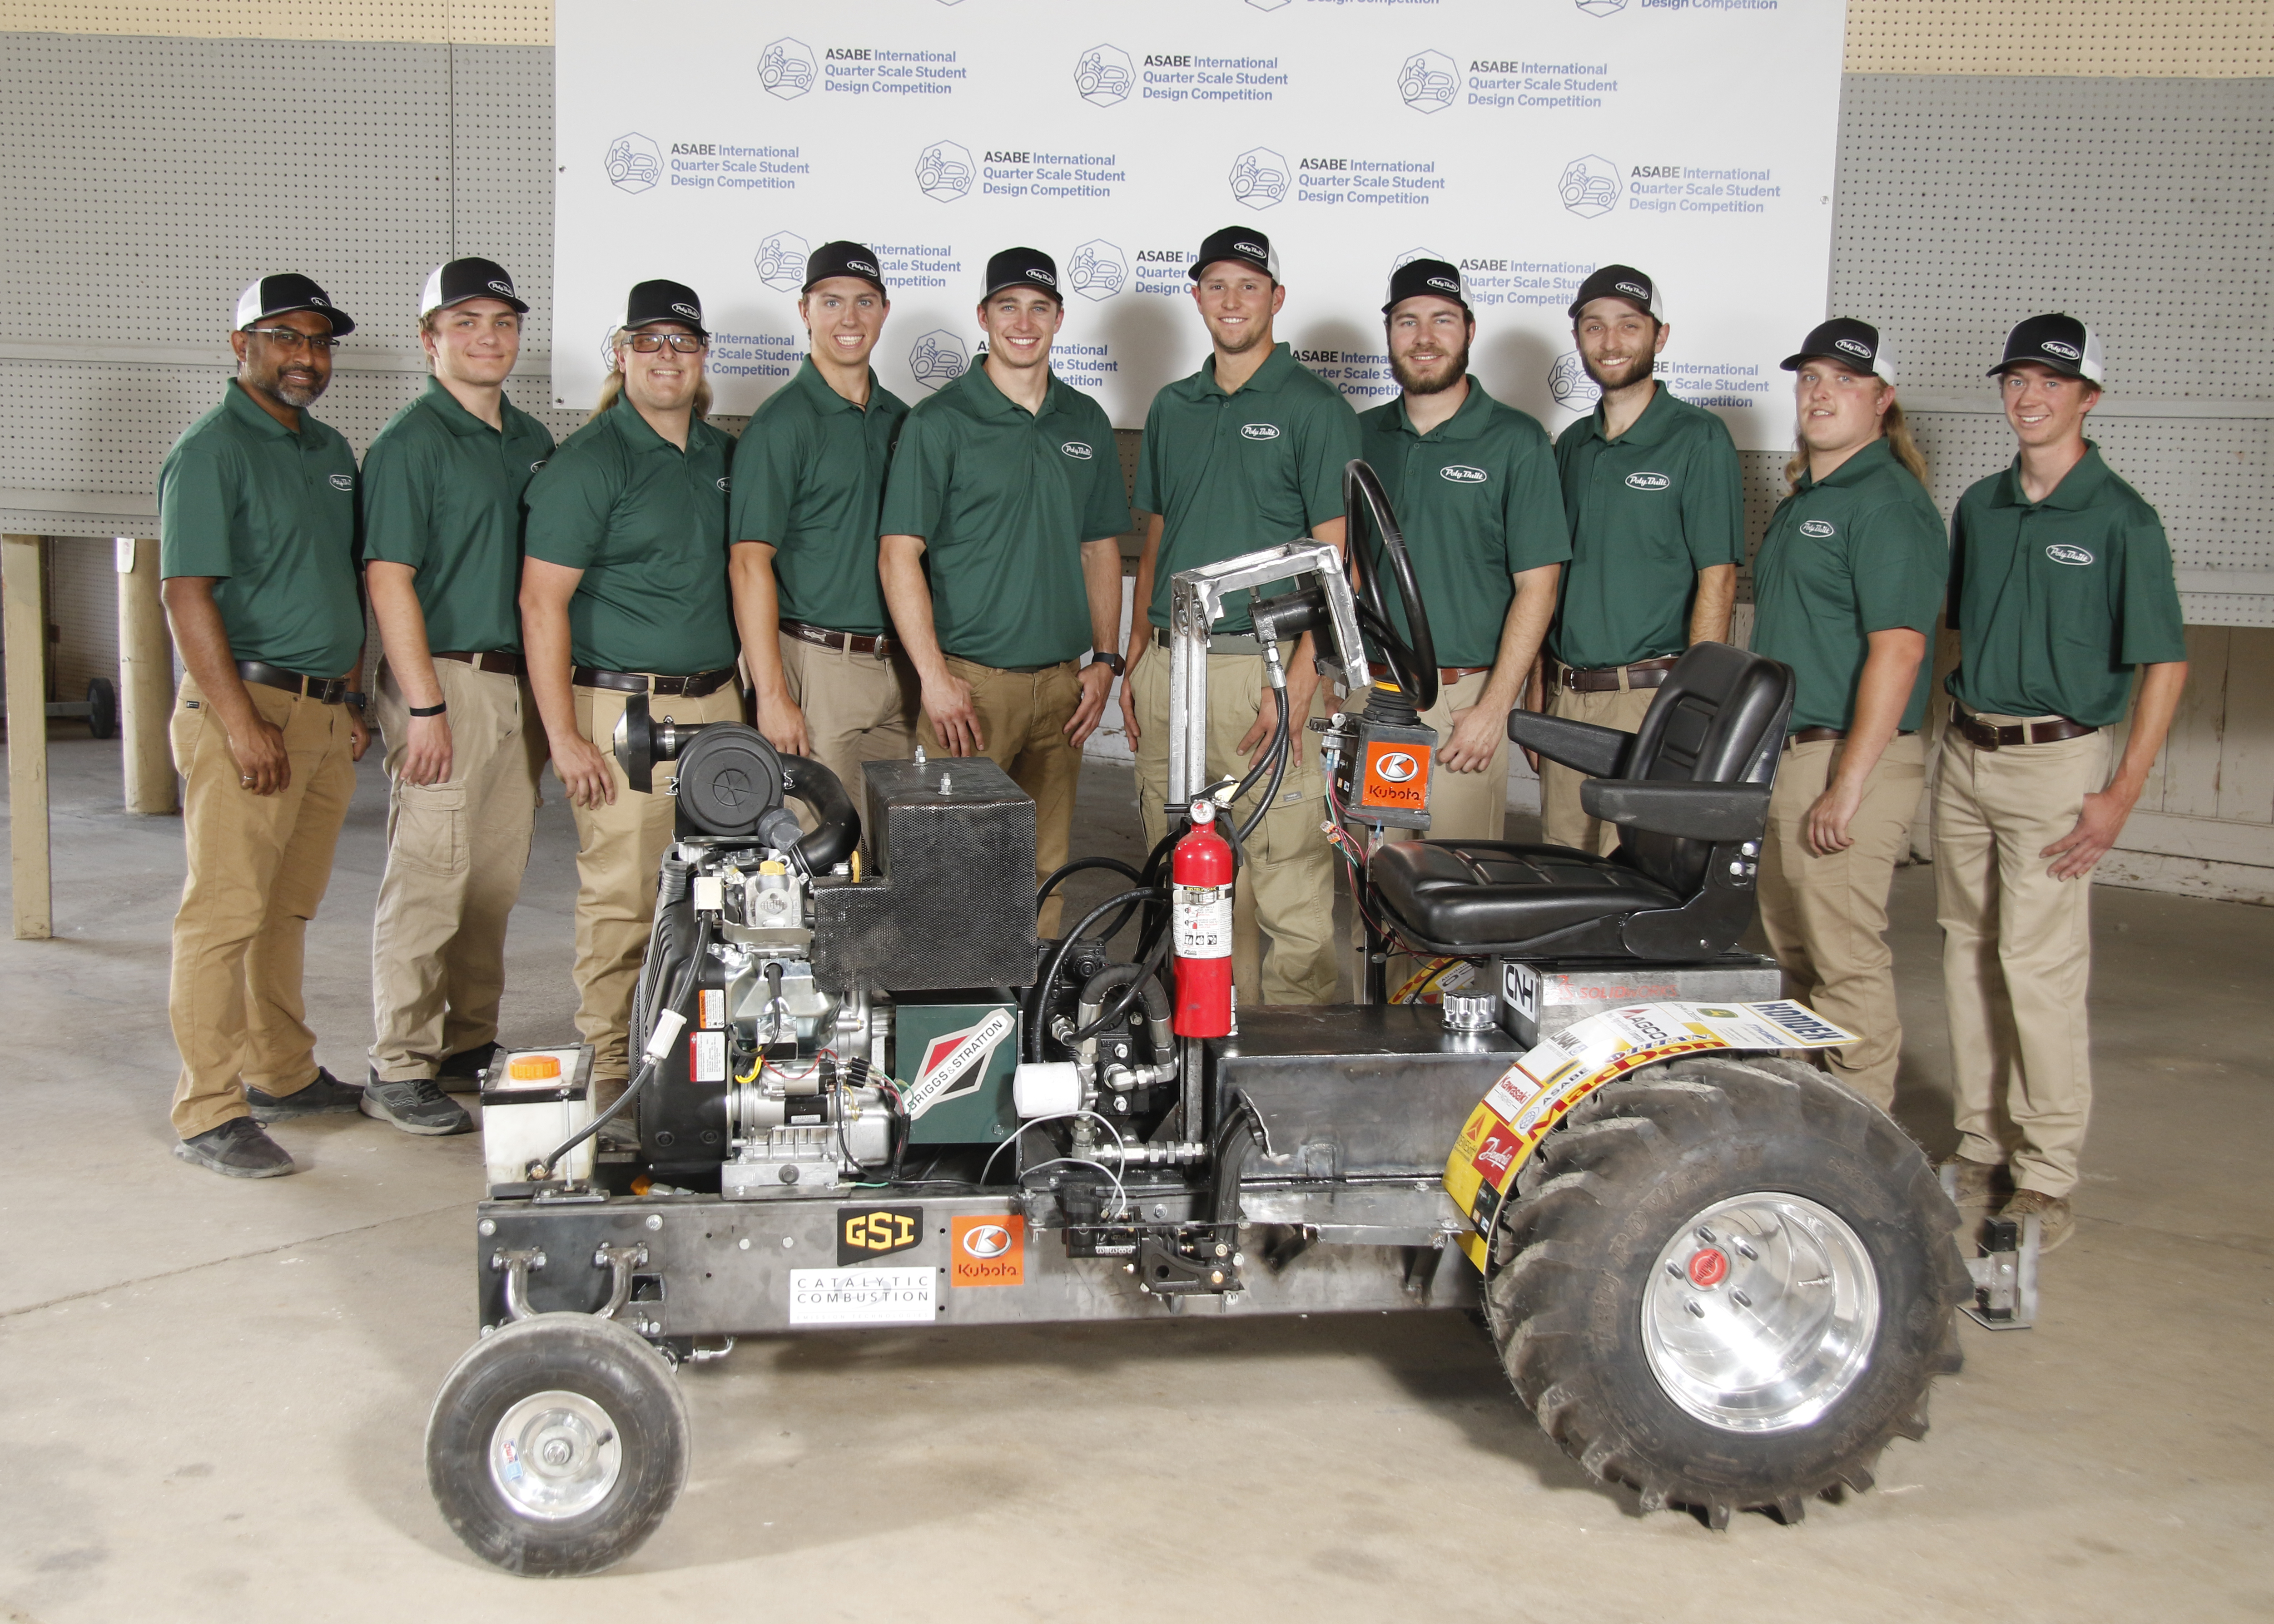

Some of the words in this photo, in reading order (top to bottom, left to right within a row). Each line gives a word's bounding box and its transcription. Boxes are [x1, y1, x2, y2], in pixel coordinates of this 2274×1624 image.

[825, 48, 872, 61] ASABE
[874, 49, 956, 63] International
[1143, 54, 1192, 68] ASABE
[1194, 55, 1278, 69] International
[824, 64, 875, 77] Quarter
[877, 65, 913, 78] Scale
[915, 66, 967, 79] Student
[1469, 60, 1519, 74] ASABE
[1521, 62, 1607, 75] International
[1143, 70, 1195, 84] Quarter
[1197, 72, 1233, 84] Scale
[1236, 72, 1288, 85] Student
[1469, 77, 1522, 90] Quarter
[1524, 78, 1561, 90] Scale
[1564, 79, 1618, 91] Student
[825, 79, 869, 94] Design
[872, 80, 952, 96] Competition
[1143, 86, 1188, 102] Design
[1191, 88, 1272, 102] Competition
[1468, 93, 1514, 108] Design
[1518, 94, 1601, 109] Competition
[670, 143, 716, 156] ASABE
[719, 144, 799, 158] International
[670, 158, 720, 172] Quarter
[722, 160, 757, 172] Scale
[759, 161, 809, 174] Student
[983, 151, 1031, 164] ASABE
[1033, 152, 1115, 166] International
[1299, 158, 1348, 171] ASABE
[1350, 159, 1435, 173] International
[983, 167, 1034, 180] Quarter
[1036, 168, 1072, 180] Scale
[1074, 169, 1126, 182] Student
[1630, 165, 1681, 178] ASABE
[1683, 167, 1770, 181] International
[671, 174, 714, 189] Design
[717, 175, 795, 190] Competition
[1299, 173, 1351, 187] Quarter
[1353, 175, 1390, 188] Scale
[1392, 176, 1445, 189] Student
[983, 182, 1028, 198] Design
[1030, 183, 1110, 198] Competition
[1630, 182, 1683, 195] Quarter
[1686, 183, 1723, 195] Scale
[1726, 184, 1781, 197] Student
[1298, 189, 1344, 205] Design
[1347, 190, 1429, 206] Competition
[1629, 198, 1676, 213] Design
[1679, 199, 1764, 214] Competition
[870, 243, 951, 256] International
[1137, 250, 1183, 262] ASABE
[1238, 245, 1252, 253] Poly
[1251, 247, 1265, 257] Built
[911, 260, 961, 272] Student
[1136, 266, 1187, 279] Quarter
[1459, 259, 1508, 271] ASABE
[1510, 260, 1596, 273] International
[1136, 281, 1180, 296] Design
[1443, 282, 1457, 290] Built
[1513, 276, 1550, 288] Scale
[1620, 284, 1633, 292] Poly
[1631, 287, 1647, 297] Built
[1471, 291, 1504, 306] esign
[715, 332, 794, 346] International
[718, 347, 752, 359] Scale
[755, 349, 804, 361] Student
[1293, 350, 1338, 362] ASABE
[1840, 342, 1856, 352] Poly
[1854, 344, 1869, 356] Built
[2046, 343, 2061, 353] Poly
[2060, 347, 2078, 358] Built
[712, 362, 790, 377] Competition
[1067, 359, 1117, 371] Student
[1672, 361, 1758, 376] International
[1344, 367, 1380, 379] Scale
[1675, 377, 1712, 391] Scale
[1715, 378, 1769, 392] Student
[1245, 426, 1260, 436] Poly
[1259, 428, 1276, 436] Built
[1066, 445, 1078, 455] Poly
[1077, 447, 1091, 456] Built
[1445, 468, 1463, 479] Poly
[1463, 470, 1484, 480] Built
[1630, 476, 1648, 488] Poly
[1647, 478, 1667, 486] Built
[1803, 523, 1815, 533] Poly
[1813, 525, 1830, 534] Built
[2050, 547, 2067, 559] Poly
[2066, 550, 2089, 563] Built
[1369, 785, 1420, 801] Kubota
[1505, 965, 1533, 1012] CNH
[1628, 1017, 1668, 1040] AGCO
[1751, 1003, 1847, 1040] KONDEX
[1549, 1029, 1582, 1051] LINAK
[1498, 1075, 1531, 1104] Kawasaki
[1543, 1067, 1589, 1106] ASABE
[1478, 1137, 1513, 1171] Danfoss
[846, 1211, 914, 1250] GSI
[958, 1263, 1017, 1277] Kubota
[797, 1276, 928, 1288] CATALYTIC
[797, 1291, 928, 1303] COMBUSTION
